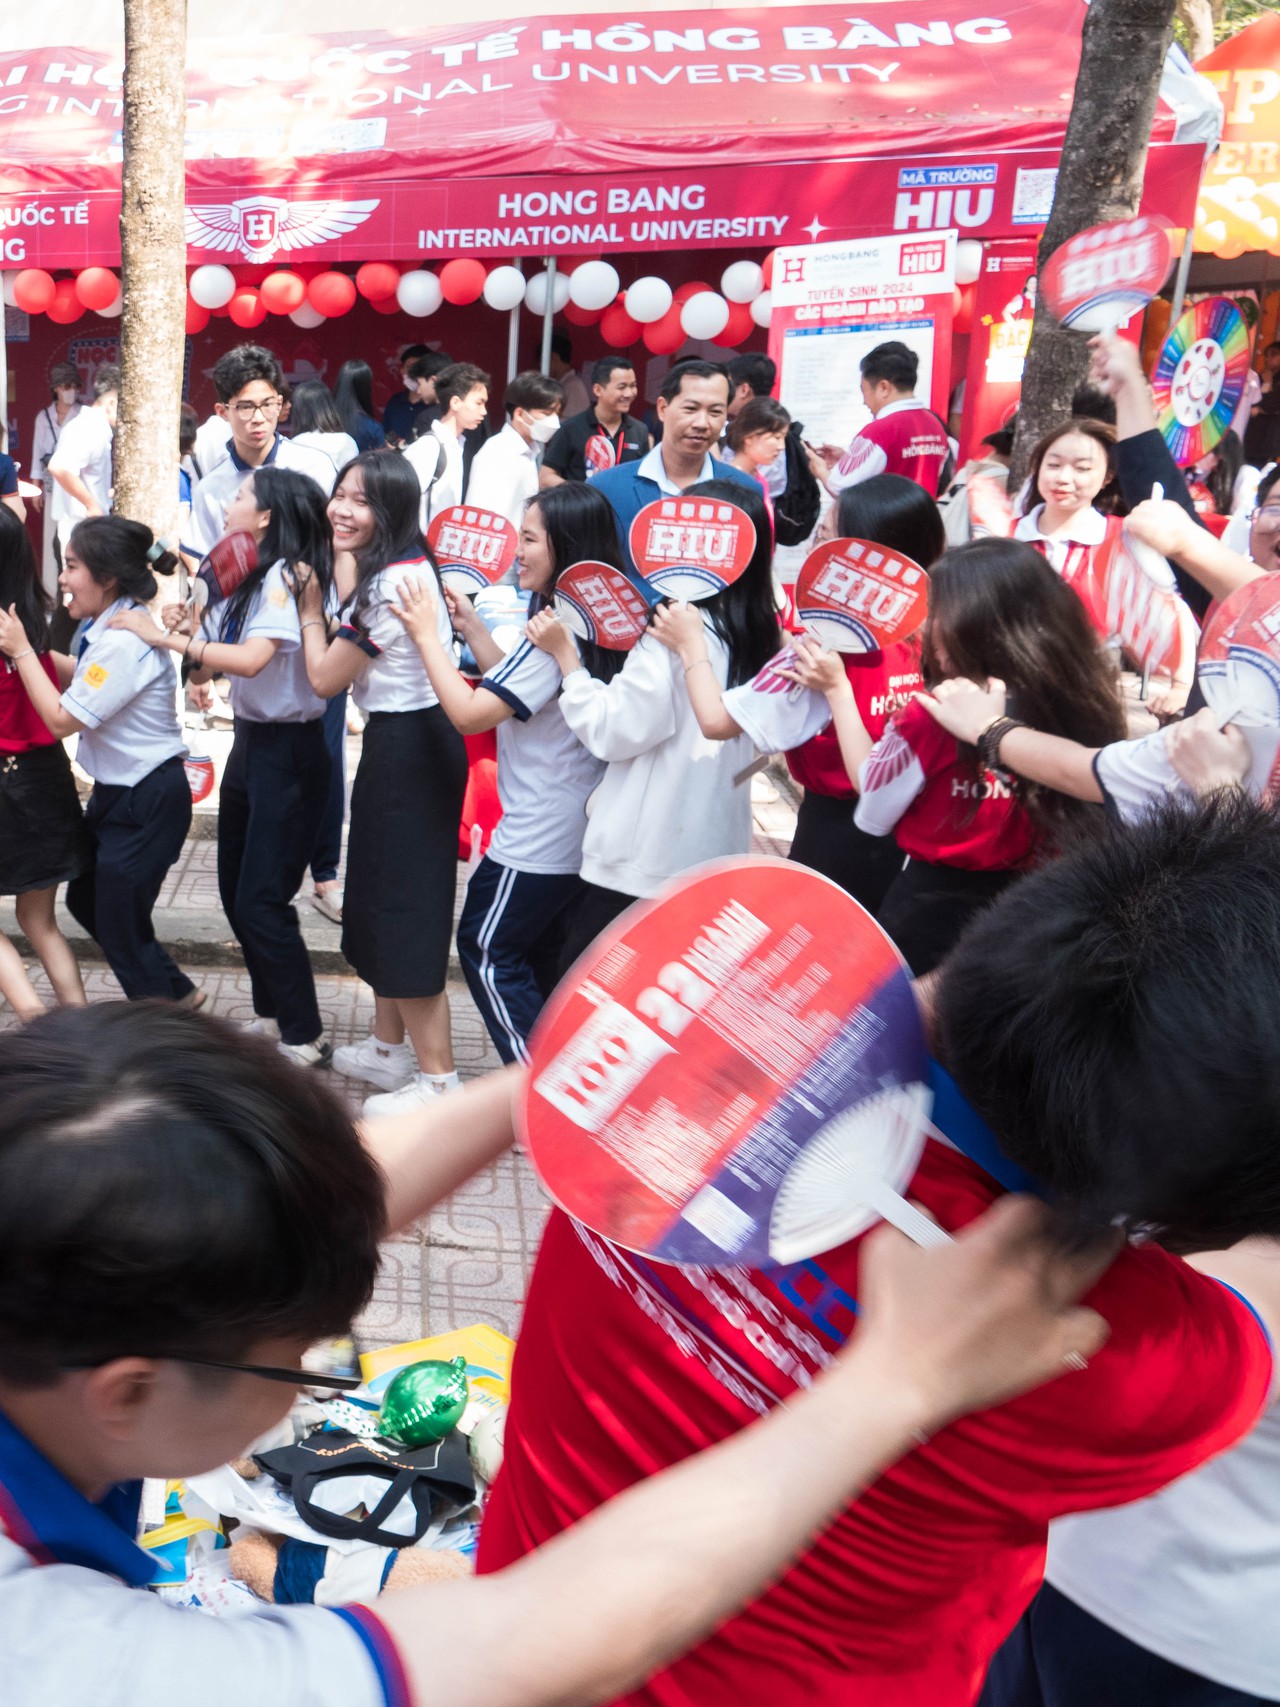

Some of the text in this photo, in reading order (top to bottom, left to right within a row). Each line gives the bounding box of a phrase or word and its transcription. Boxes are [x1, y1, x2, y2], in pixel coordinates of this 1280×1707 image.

[44, 62, 123, 93] HỌ
[432, 26, 527, 67] TẾ
[542, 21, 760, 53] HỒNG
[782, 17, 1012, 51] BÀNG
[531, 61, 901, 85] UNIVERSITY
[901, 165, 995, 186] MÃ TRƯỜNG
[60, 198, 91, 225] TẾ
[499, 185, 706, 218] HONG BANG
[893, 188, 995, 230] HIU
[418, 215, 789, 249] INTERNATIONAL UNIVERSITY
[902, 251, 942, 274] HIU
[849, 285, 878, 298] SINH
[883, 282, 914, 295] 2024
[437, 526, 502, 563] HIU
[650, 524, 732, 561] HIU
[575, 576, 636, 635] HIU
[813, 560, 909, 622] HIU
